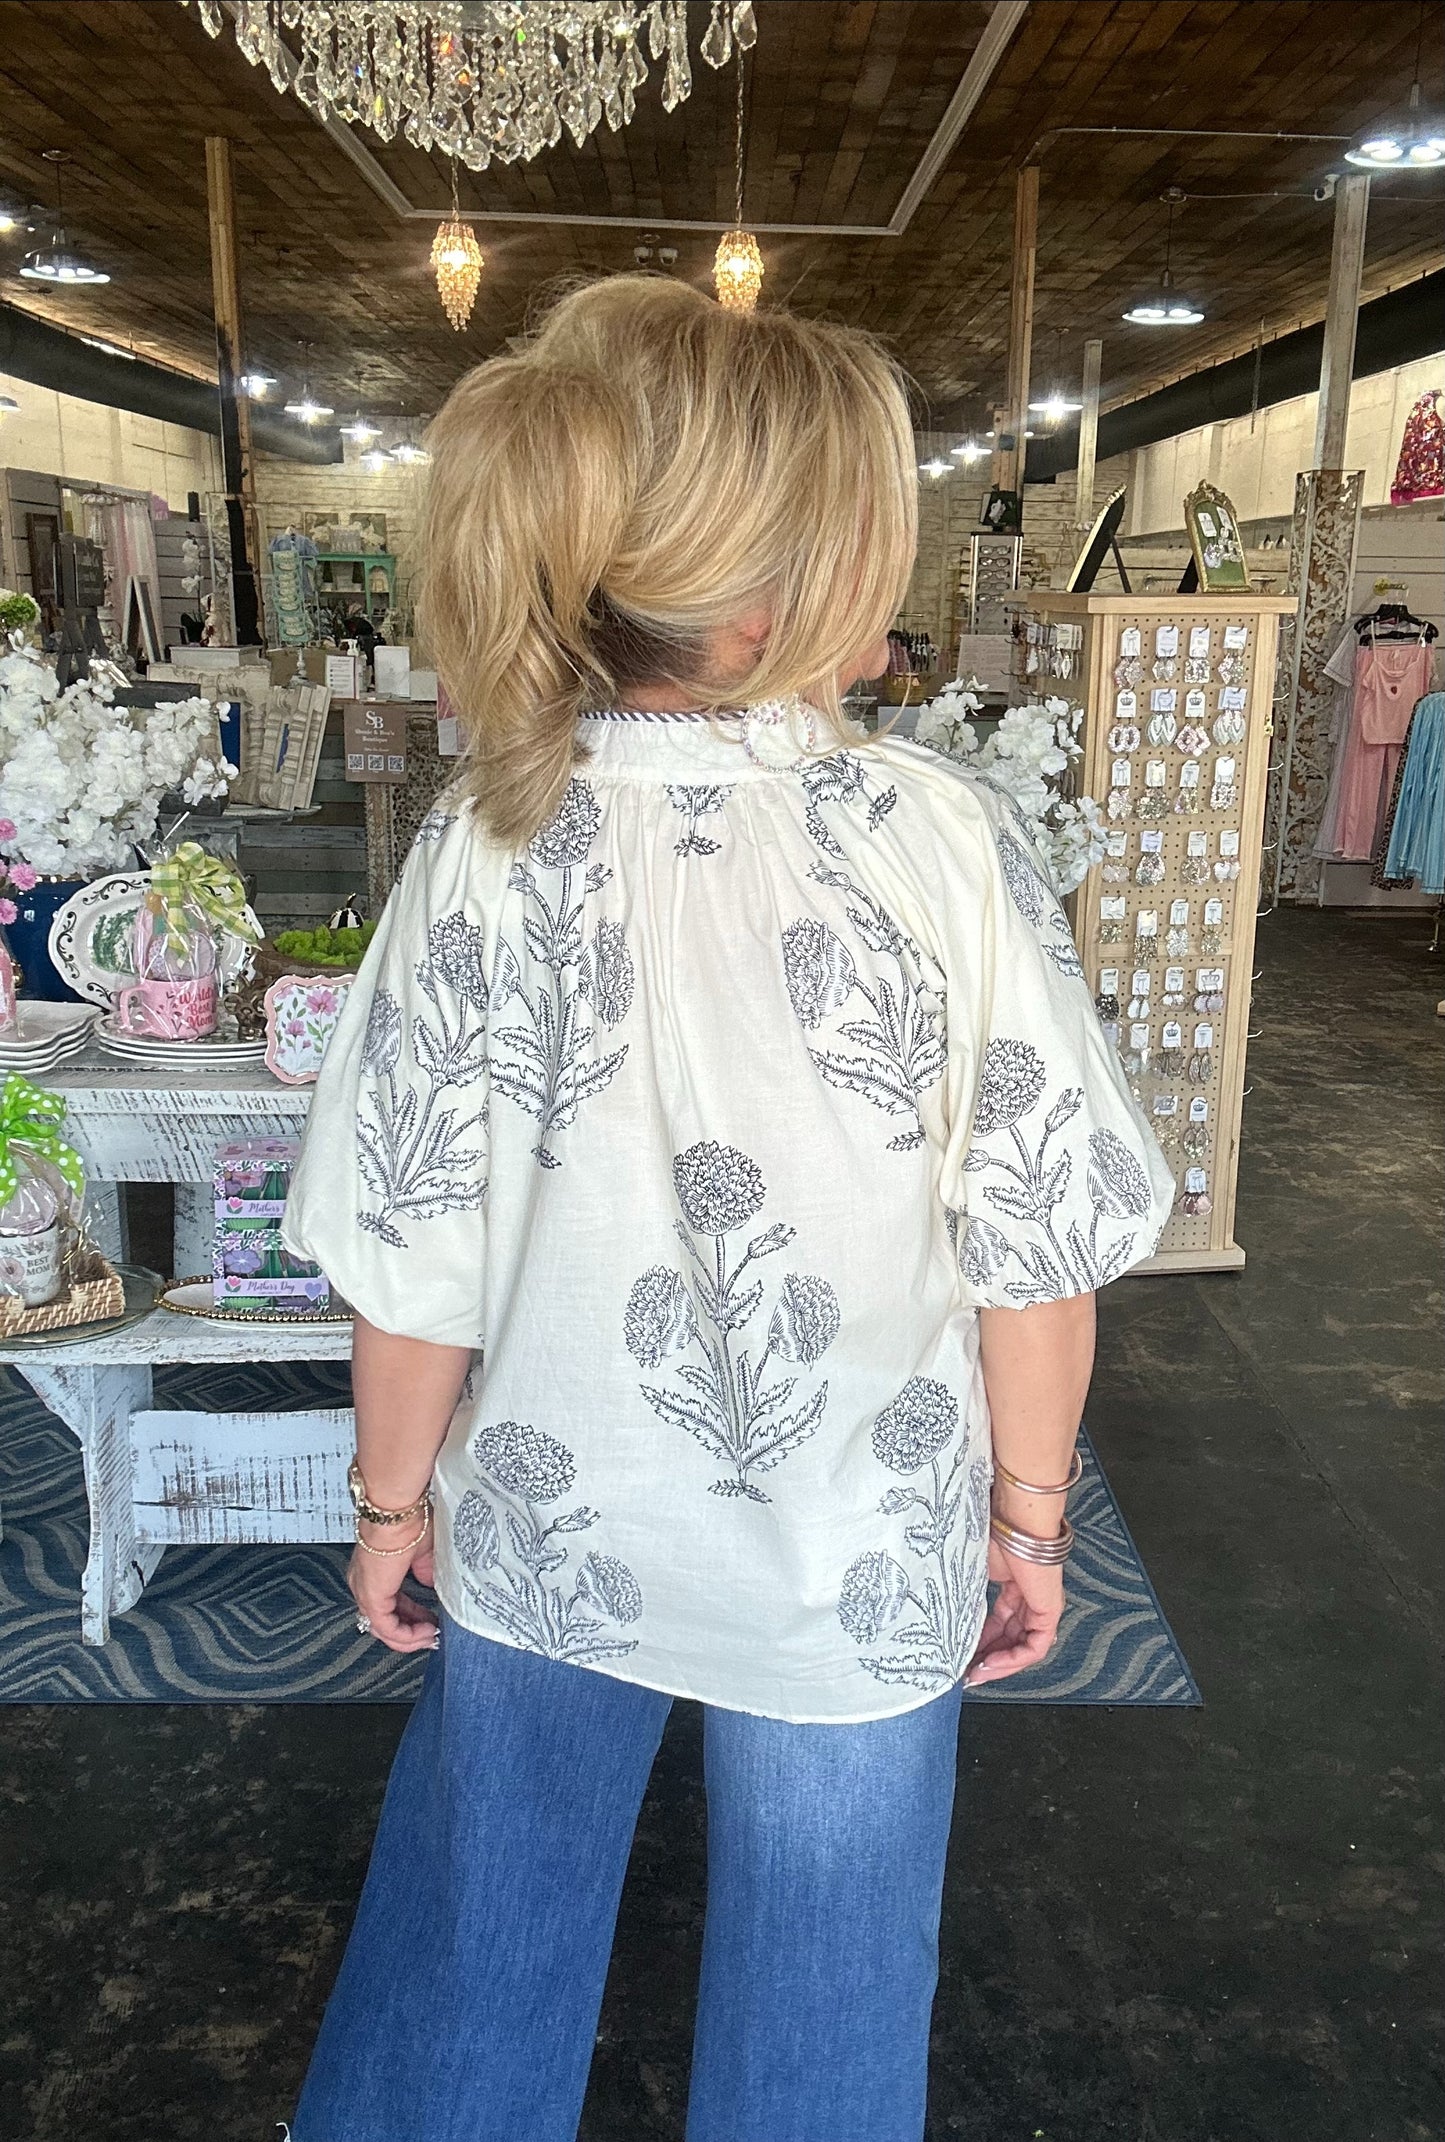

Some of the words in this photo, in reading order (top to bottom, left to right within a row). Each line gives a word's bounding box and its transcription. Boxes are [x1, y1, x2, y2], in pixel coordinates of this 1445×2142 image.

[365, 710, 384, 729] SB
[187, 1014, 213, 1028] Mom
[27, 1255, 49, 1268] BEST
[26, 1264, 51, 1276] MOM
[280, 1280, 295, 1295] Day
